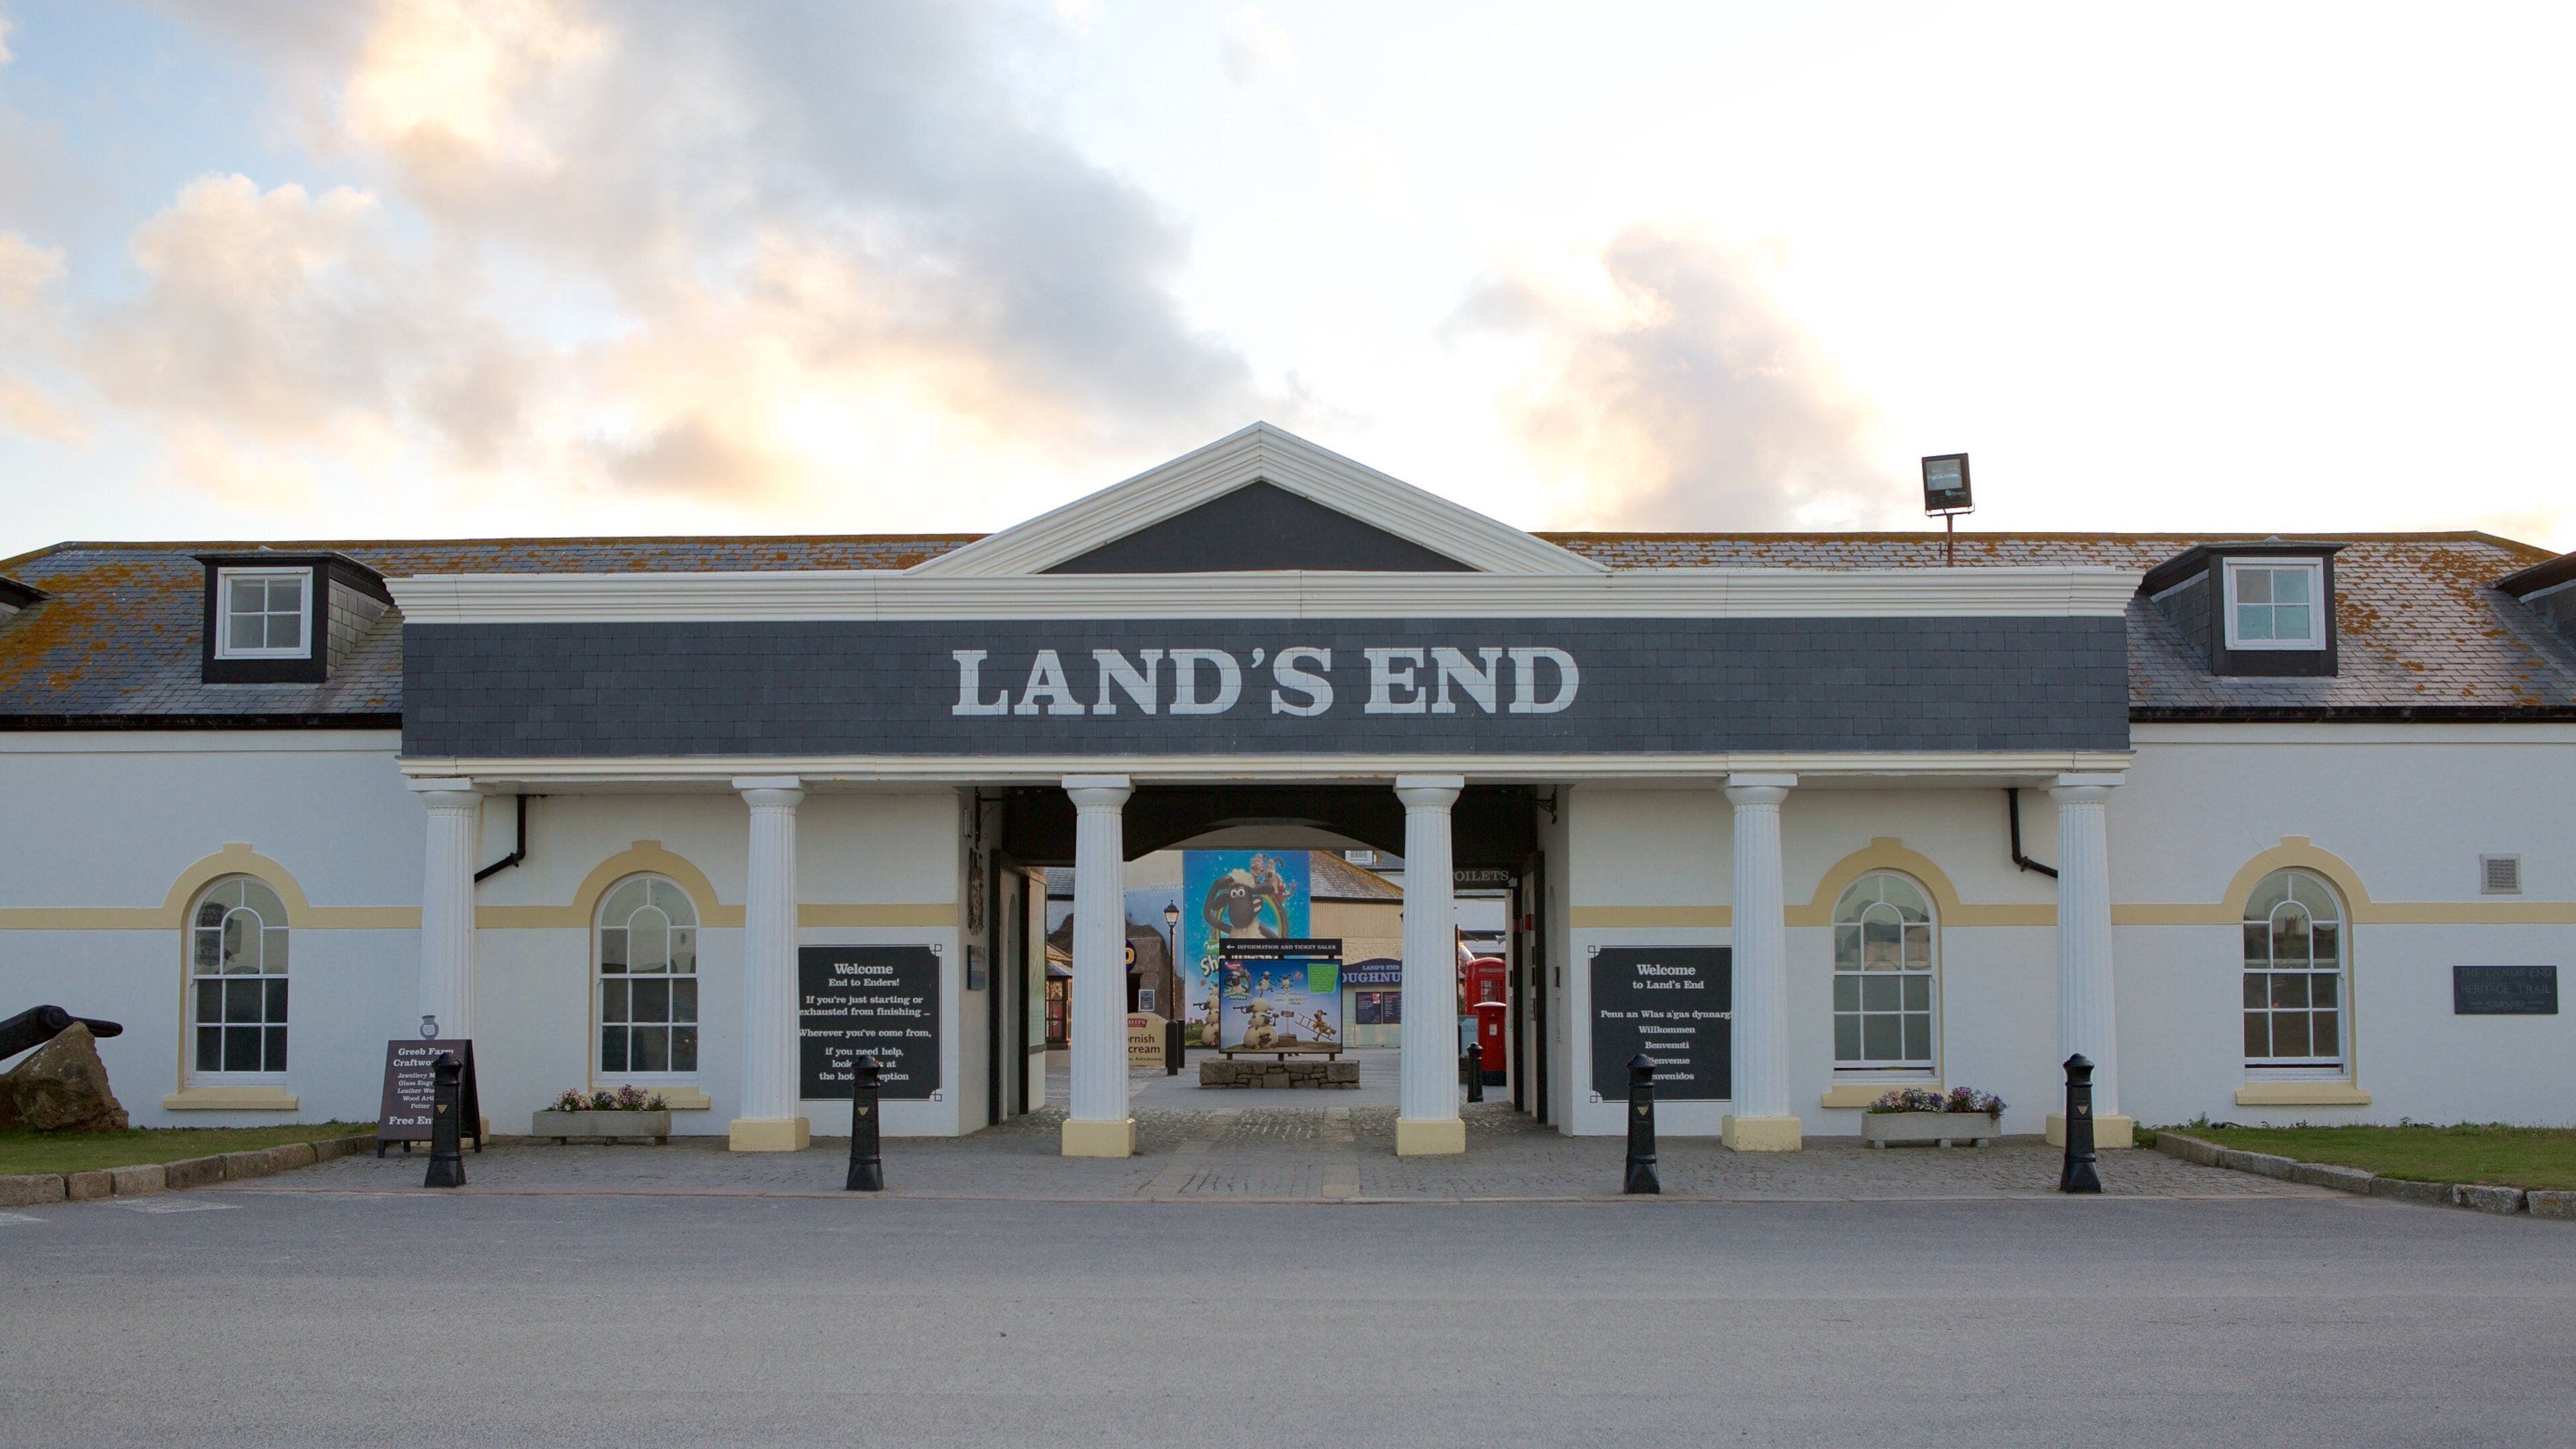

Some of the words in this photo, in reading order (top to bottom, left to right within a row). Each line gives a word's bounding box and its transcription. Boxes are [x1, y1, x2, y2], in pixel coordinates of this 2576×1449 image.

[953, 647, 1333, 716] LAND'S
[1364, 647, 1579, 715] END
[1453, 870, 1509, 881] OILETS
[835, 963, 893, 974] Welcome
[1637, 965, 1696, 975] Welcome
[1633, 981, 1643, 989] to
[1646, 980, 1680, 989] Land's
[817, 996, 846, 1006] you're
[848, 996, 867, 1005] just
[870, 996, 910, 1006] starting
[877, 1008, 921, 1017] finishing
[846, 1029, 875, 1038] you've
[906, 1029, 931, 1037] from,
[856, 1047, 878, 1055] need
[882, 1048, 904, 1057] help,
[389, 1116, 414, 1124] Free
